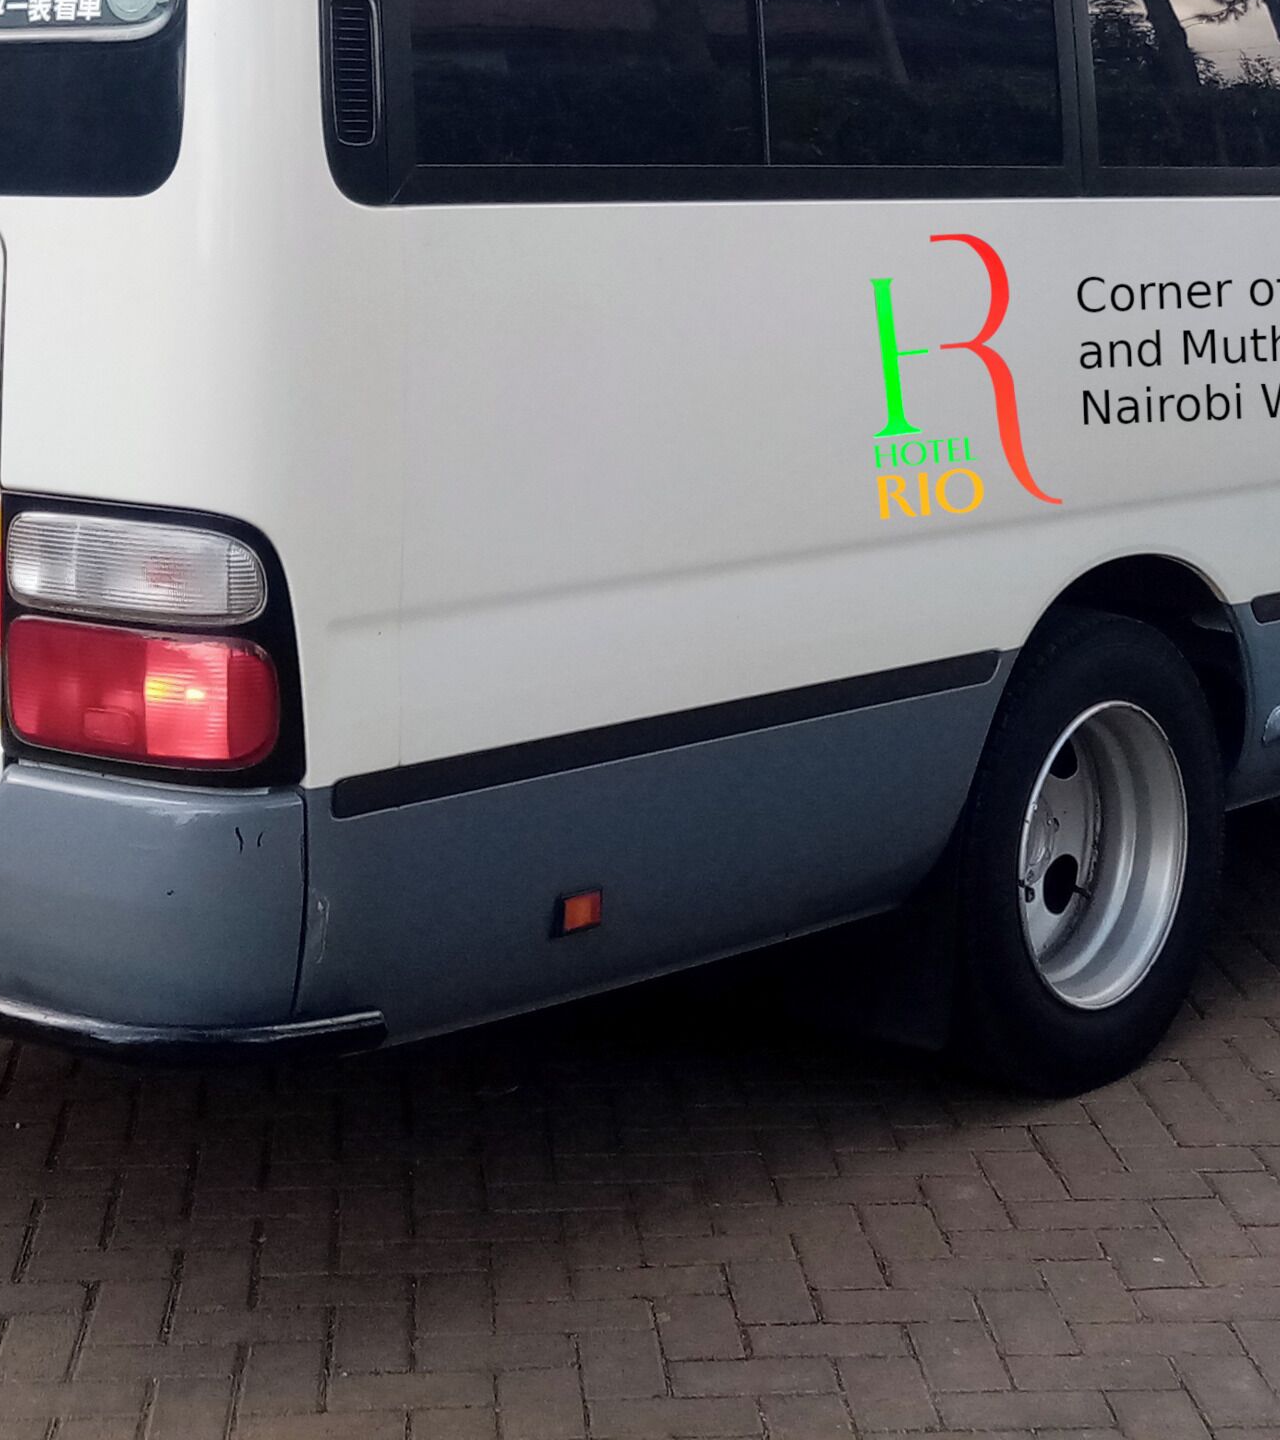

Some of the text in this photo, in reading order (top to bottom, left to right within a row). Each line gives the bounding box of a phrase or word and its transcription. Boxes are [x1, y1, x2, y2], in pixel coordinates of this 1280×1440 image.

[1076, 275, 1233, 313] Corner
[1079, 329, 1162, 369] and
[1082, 382, 1242, 426] Nairobi
[873, 436, 977, 469] HOTEL
[877, 468, 984, 520] RIO
